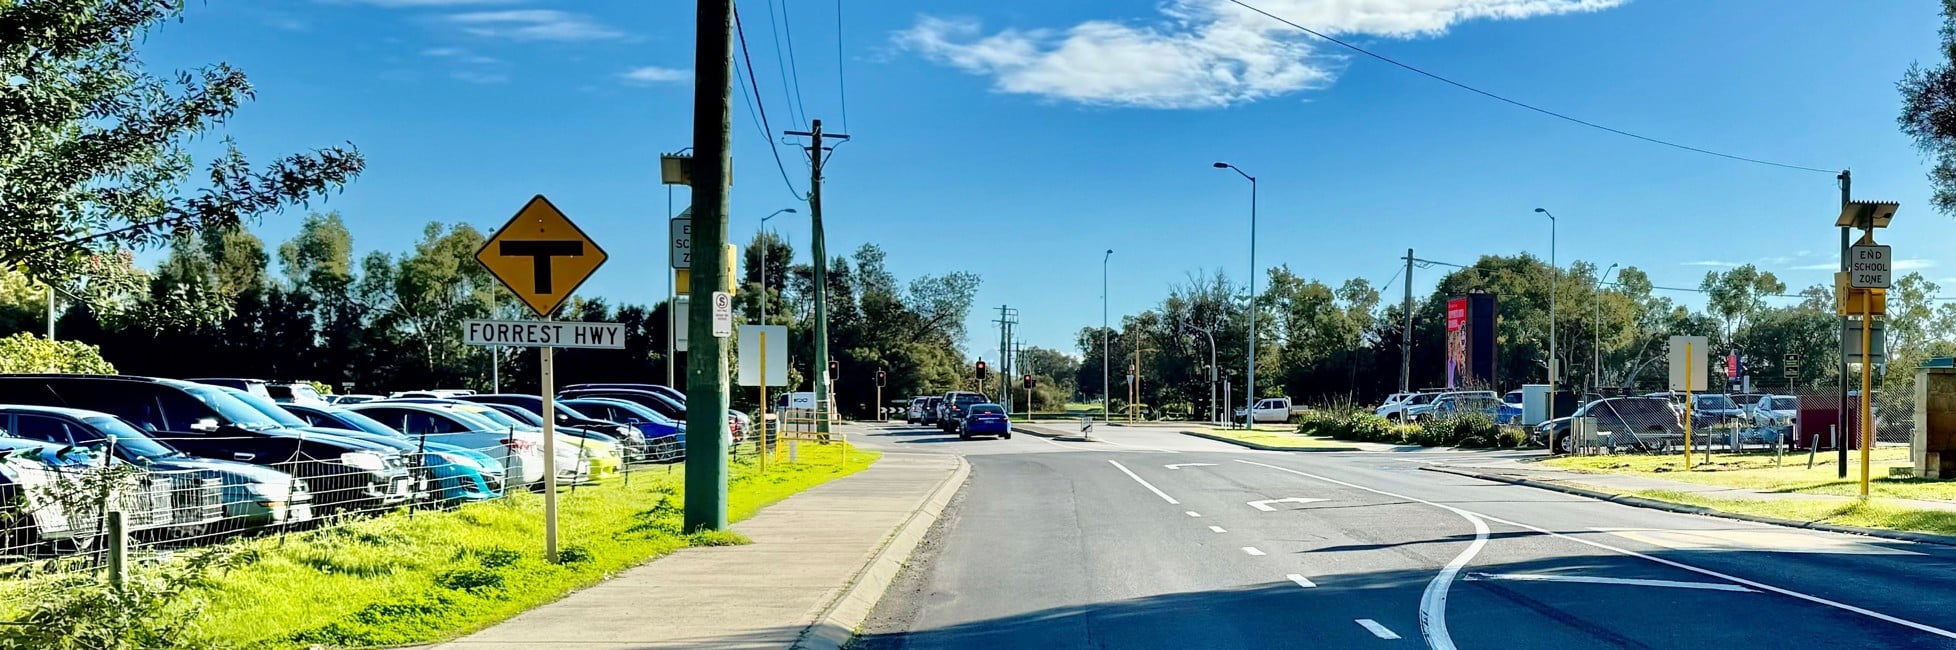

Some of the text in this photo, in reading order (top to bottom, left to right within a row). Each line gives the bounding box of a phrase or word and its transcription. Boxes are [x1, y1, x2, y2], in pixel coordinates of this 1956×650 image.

[1860, 250, 1882, 260] END
[1854, 262, 1888, 272] SCHOOL
[1859, 274, 1883, 284] ZONE
[719, 296, 726, 307] S
[470, 323, 618, 345] FORREST HWY
